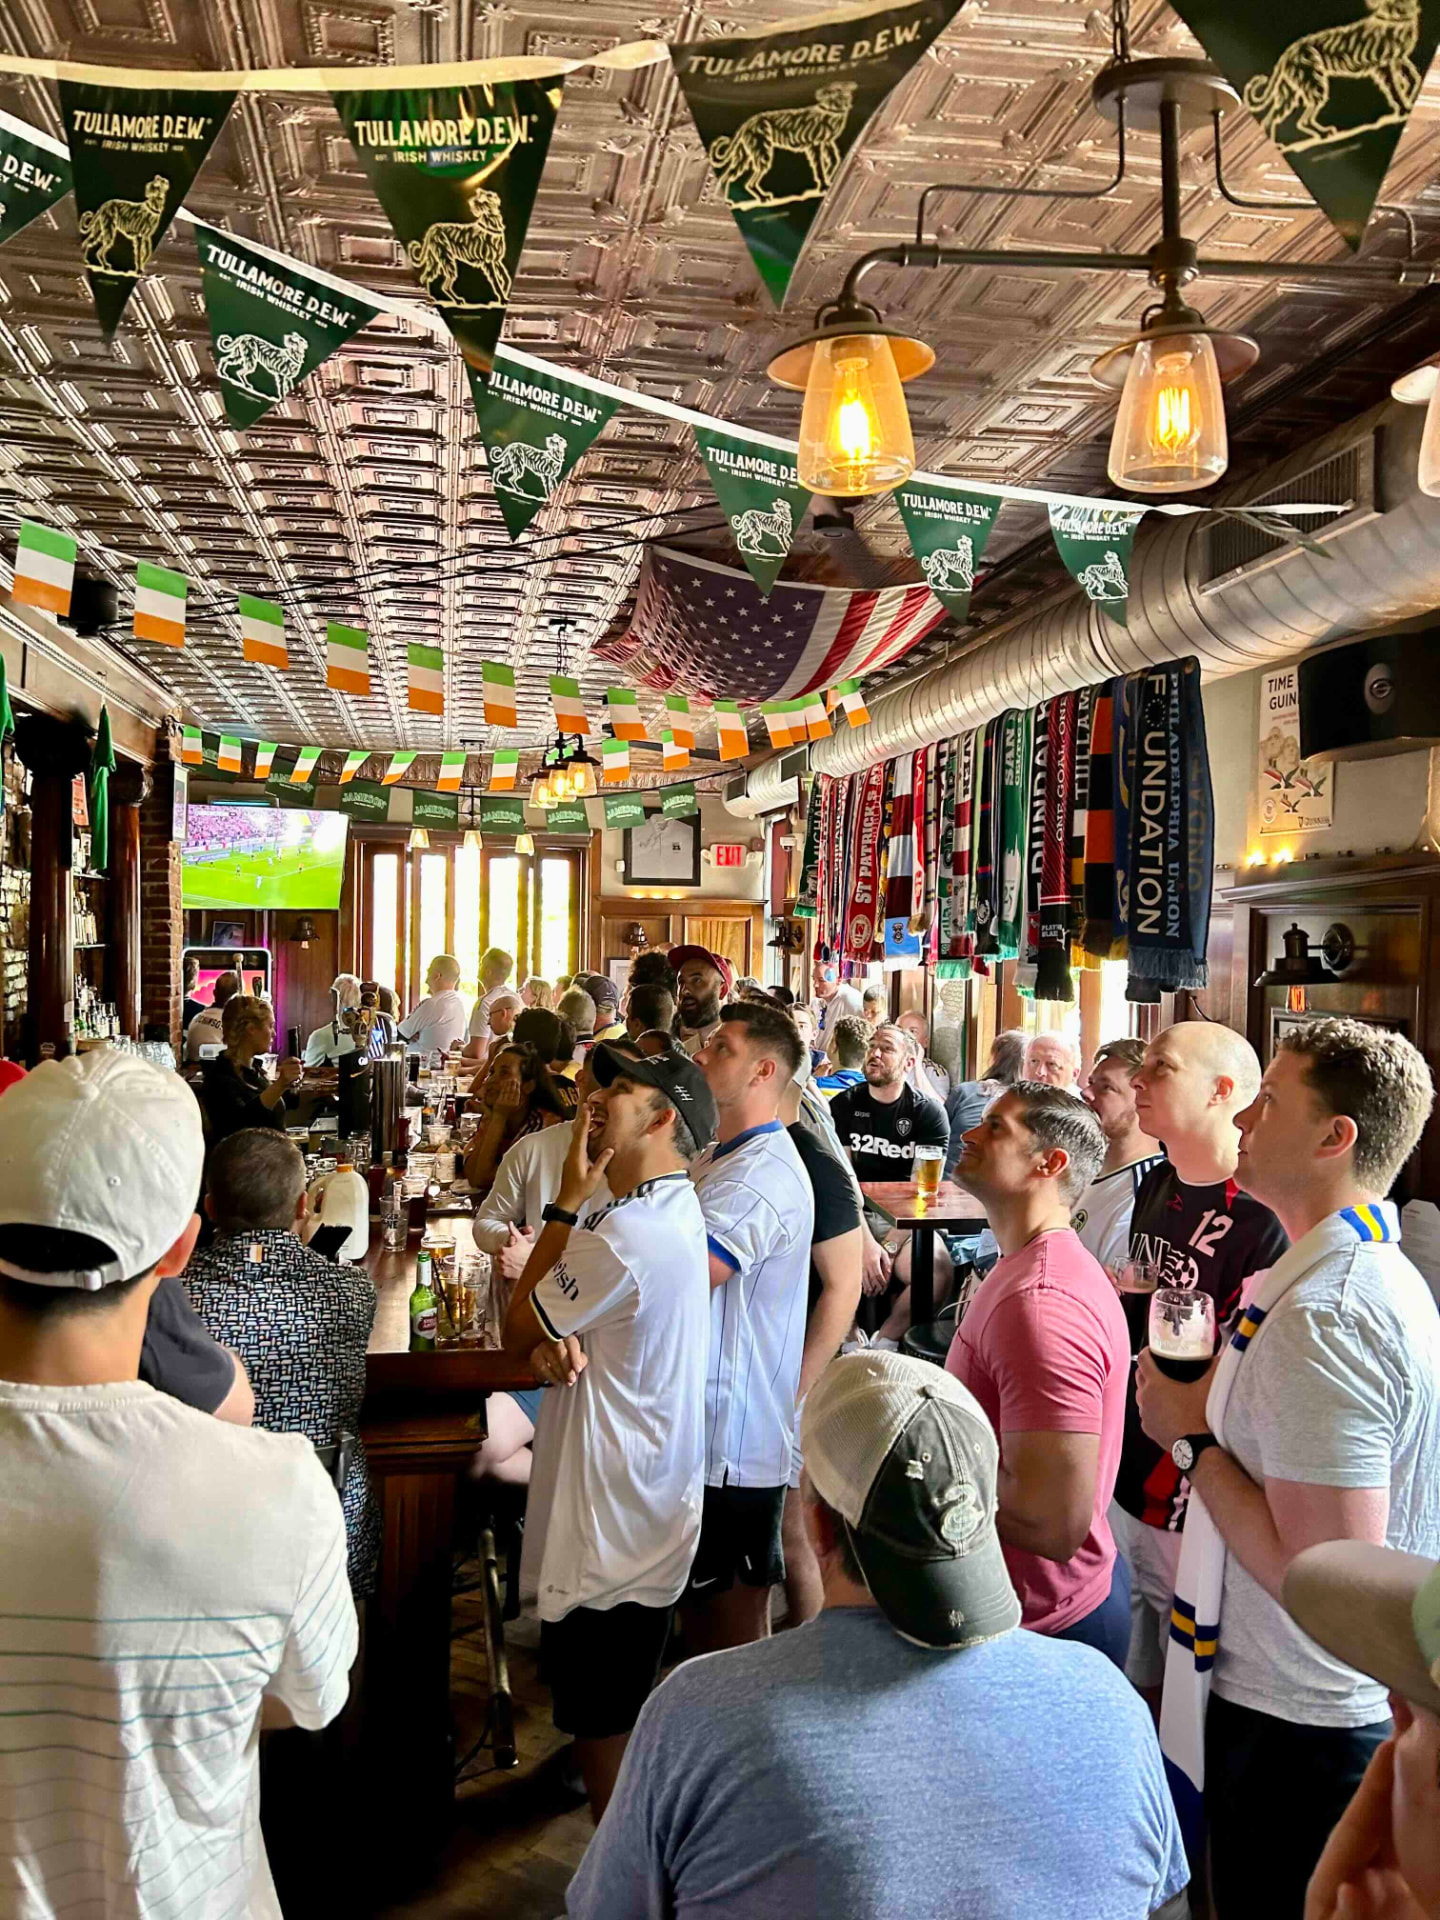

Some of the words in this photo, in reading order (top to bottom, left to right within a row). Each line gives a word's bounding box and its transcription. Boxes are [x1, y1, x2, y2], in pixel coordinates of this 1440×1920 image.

[687, 43, 844, 76] TULLAMORE
[734, 68, 778, 83] IRISH
[784, 62, 859, 77] WHISKEY
[73, 110, 160, 138] TULLAMORE
[354, 119, 472, 147] TULLAMORE
[102, 140, 129, 150] IRISH
[131, 142, 169, 153] WHISKEY
[394, 151, 427, 162] IRISH
[431, 150, 487, 161] WHISKEY
[207, 244, 305, 306] TULLAMORE
[236, 279, 265, 299] IRISH
[266, 293, 312, 321] WHISKEY
[503, 393, 527, 408] IRISH
[529, 402, 568, 422] WHISKEY
[706, 446, 777, 477] TULLAMORE
[731, 469, 752, 479] IRISH
[754, 473, 786, 488] WHISKEY
[901, 493, 964, 515] TULLAMORE
[1268, 674, 1294, 693] TIME
[1005, 728, 1015, 786] SAN
[1167, 673, 1180, 852] PHILADELPHIA
[342, 792, 387, 809] JAMESON
[414, 804, 457, 819] JAMESON
[482, 810, 521, 822] JAMESON
[1056, 805, 1065, 842] ONE
[716, 845, 742, 867] EXIT
[855, 880, 872, 904] ST
[849, 1133, 915, 1159] 32Red
[1188, 1208, 1234, 1257] 12
